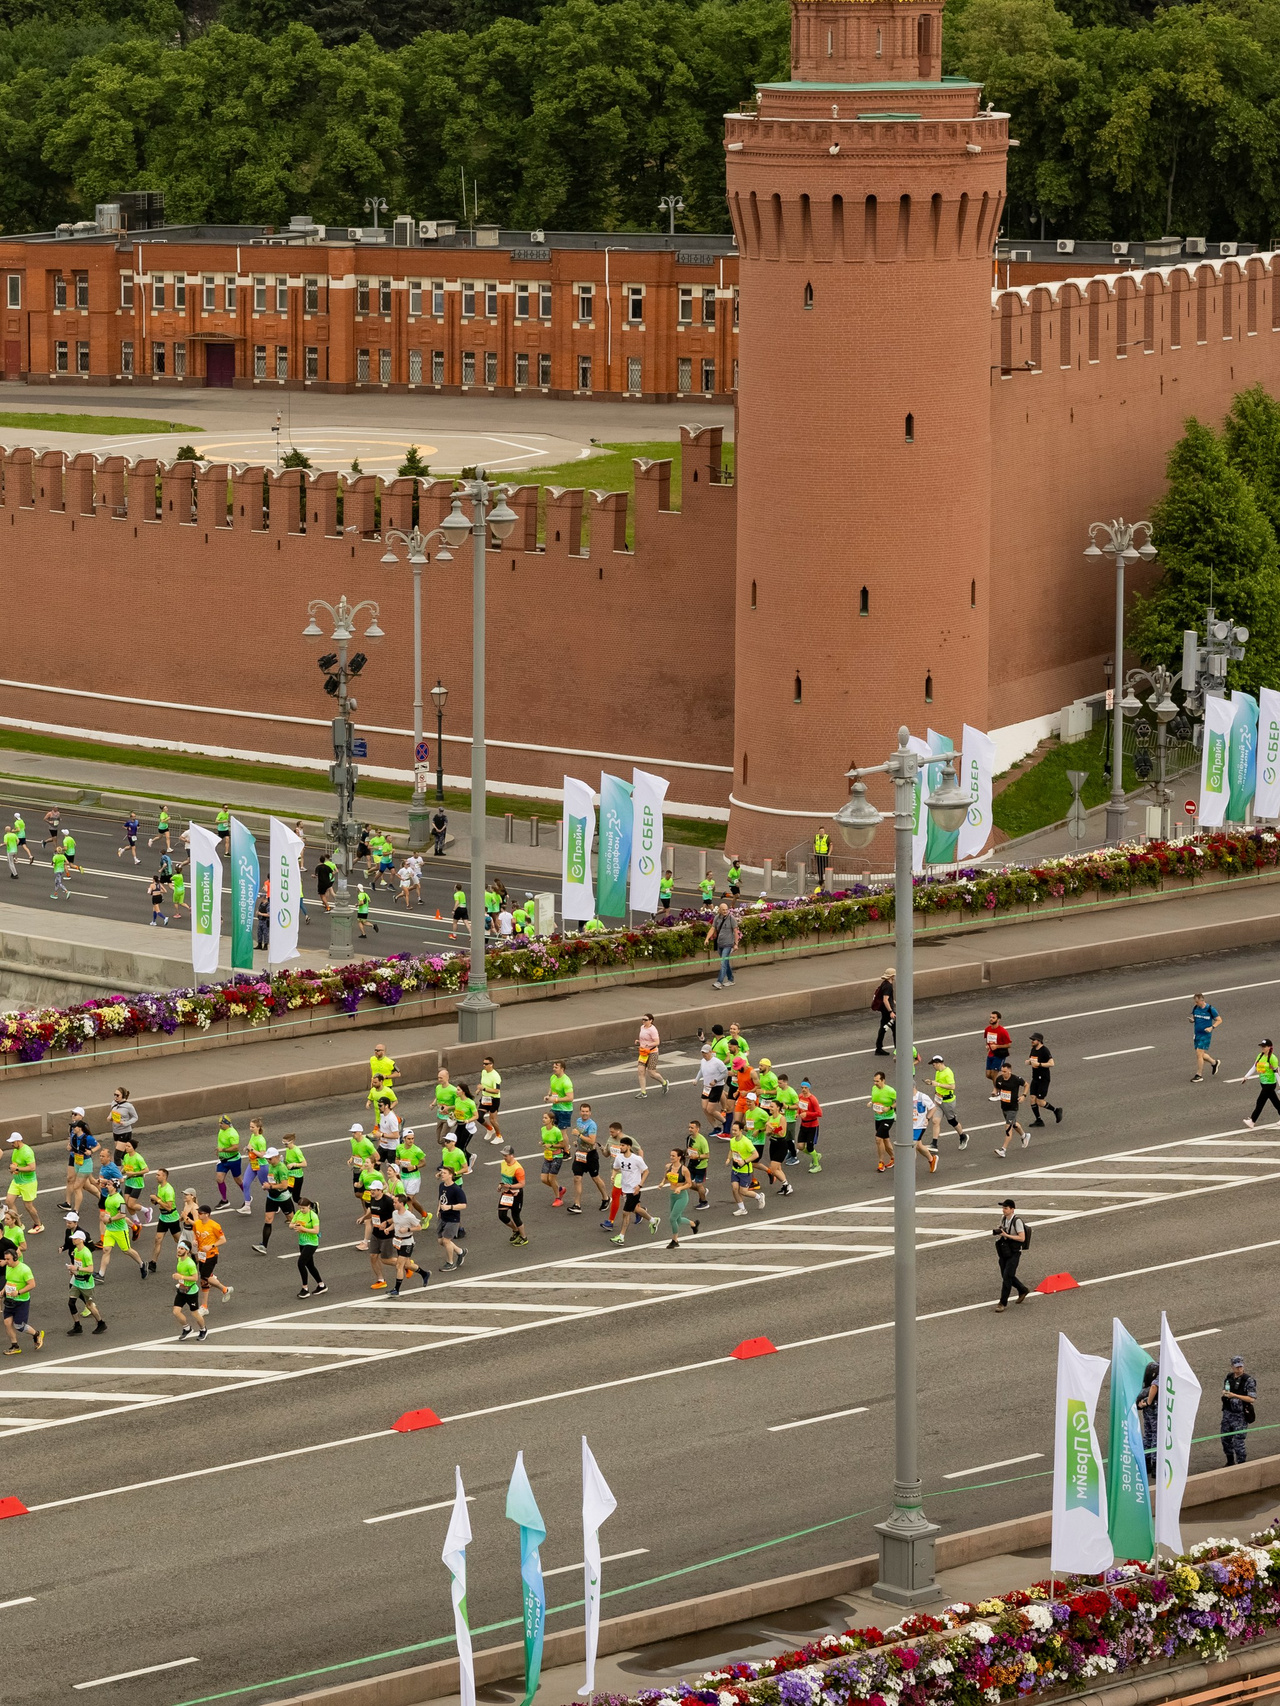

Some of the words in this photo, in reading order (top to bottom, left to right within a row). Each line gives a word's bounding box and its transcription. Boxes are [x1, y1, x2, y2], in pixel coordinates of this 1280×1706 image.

[1212, 739, 1223, 774] Прайм
[1267, 720, 1280, 763] СБЕР
[572, 824, 583, 862] Прайм
[642, 805, 654, 851] СБЕР
[605, 831, 613, 875] зелёный
[612, 837, 621, 882] марафон
[200, 872, 210, 912] Прайм
[280, 855, 290, 903] СБЕР
[238, 879, 246, 925] зелёный
